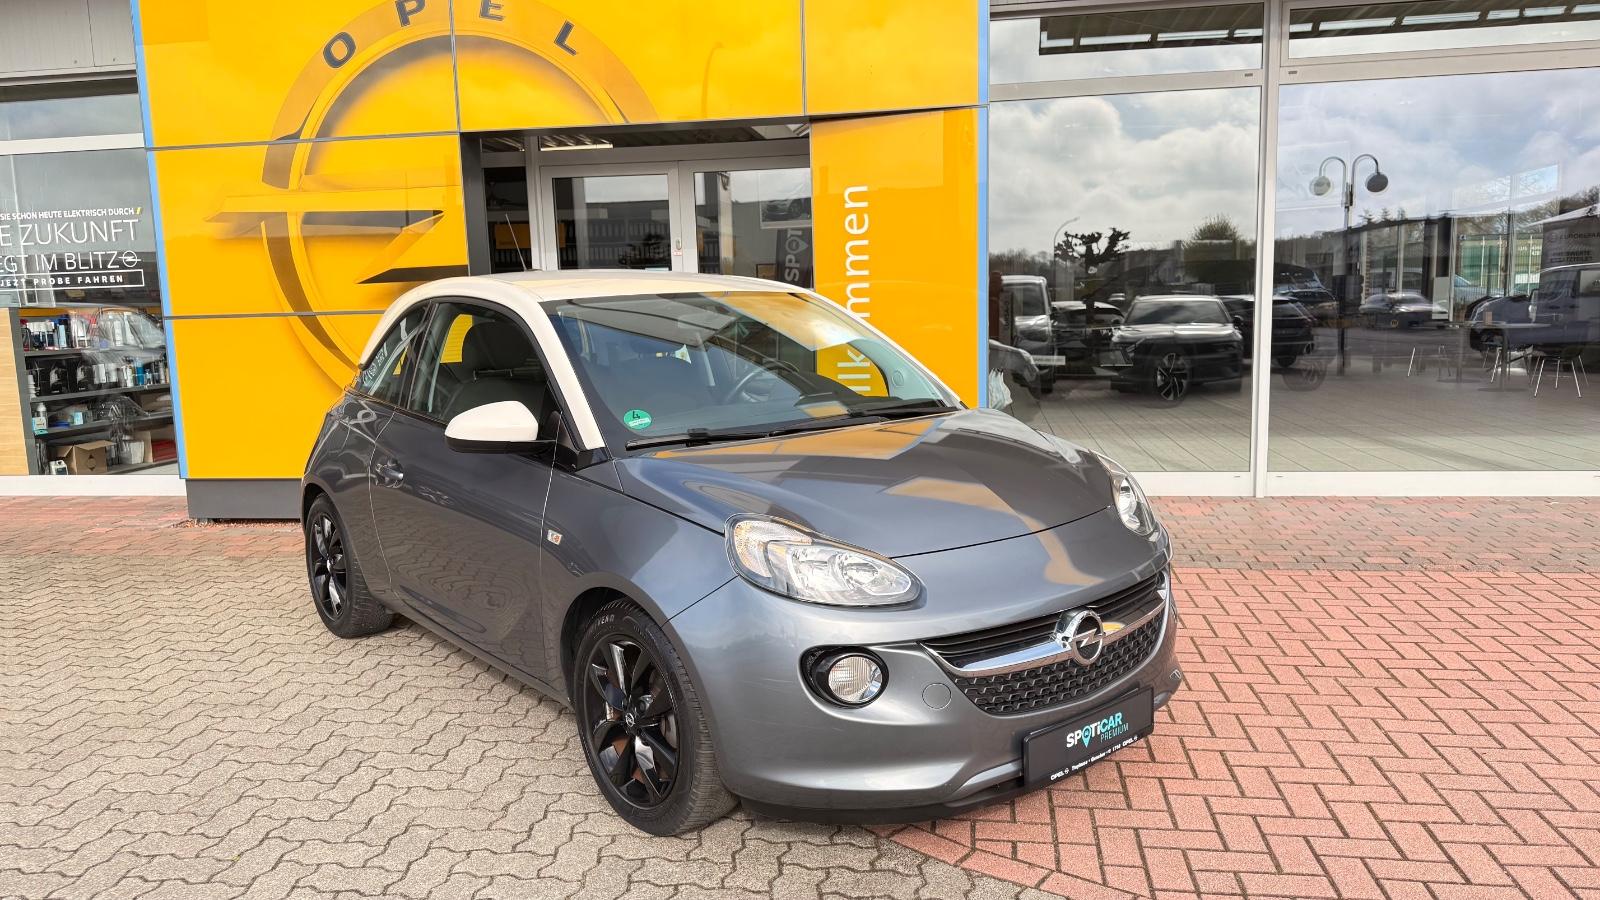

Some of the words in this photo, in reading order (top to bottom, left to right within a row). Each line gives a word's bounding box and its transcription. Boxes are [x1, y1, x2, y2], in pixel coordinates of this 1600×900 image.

[323, 0, 579, 69] OPEL
[38, 210, 63, 219] HEUTE
[63, 208, 107, 218] ELEKTRISCH
[108, 207, 135, 216] DURCH
[19, 218, 139, 246] ZUKUNFT
[35, 253, 58, 271] IM
[65, 251, 120, 270] BLITZ
[34, 276, 71, 286] PROBE
[77, 275, 123, 284] FAHREN
[1100, 723, 1129, 743] PREMIUM
